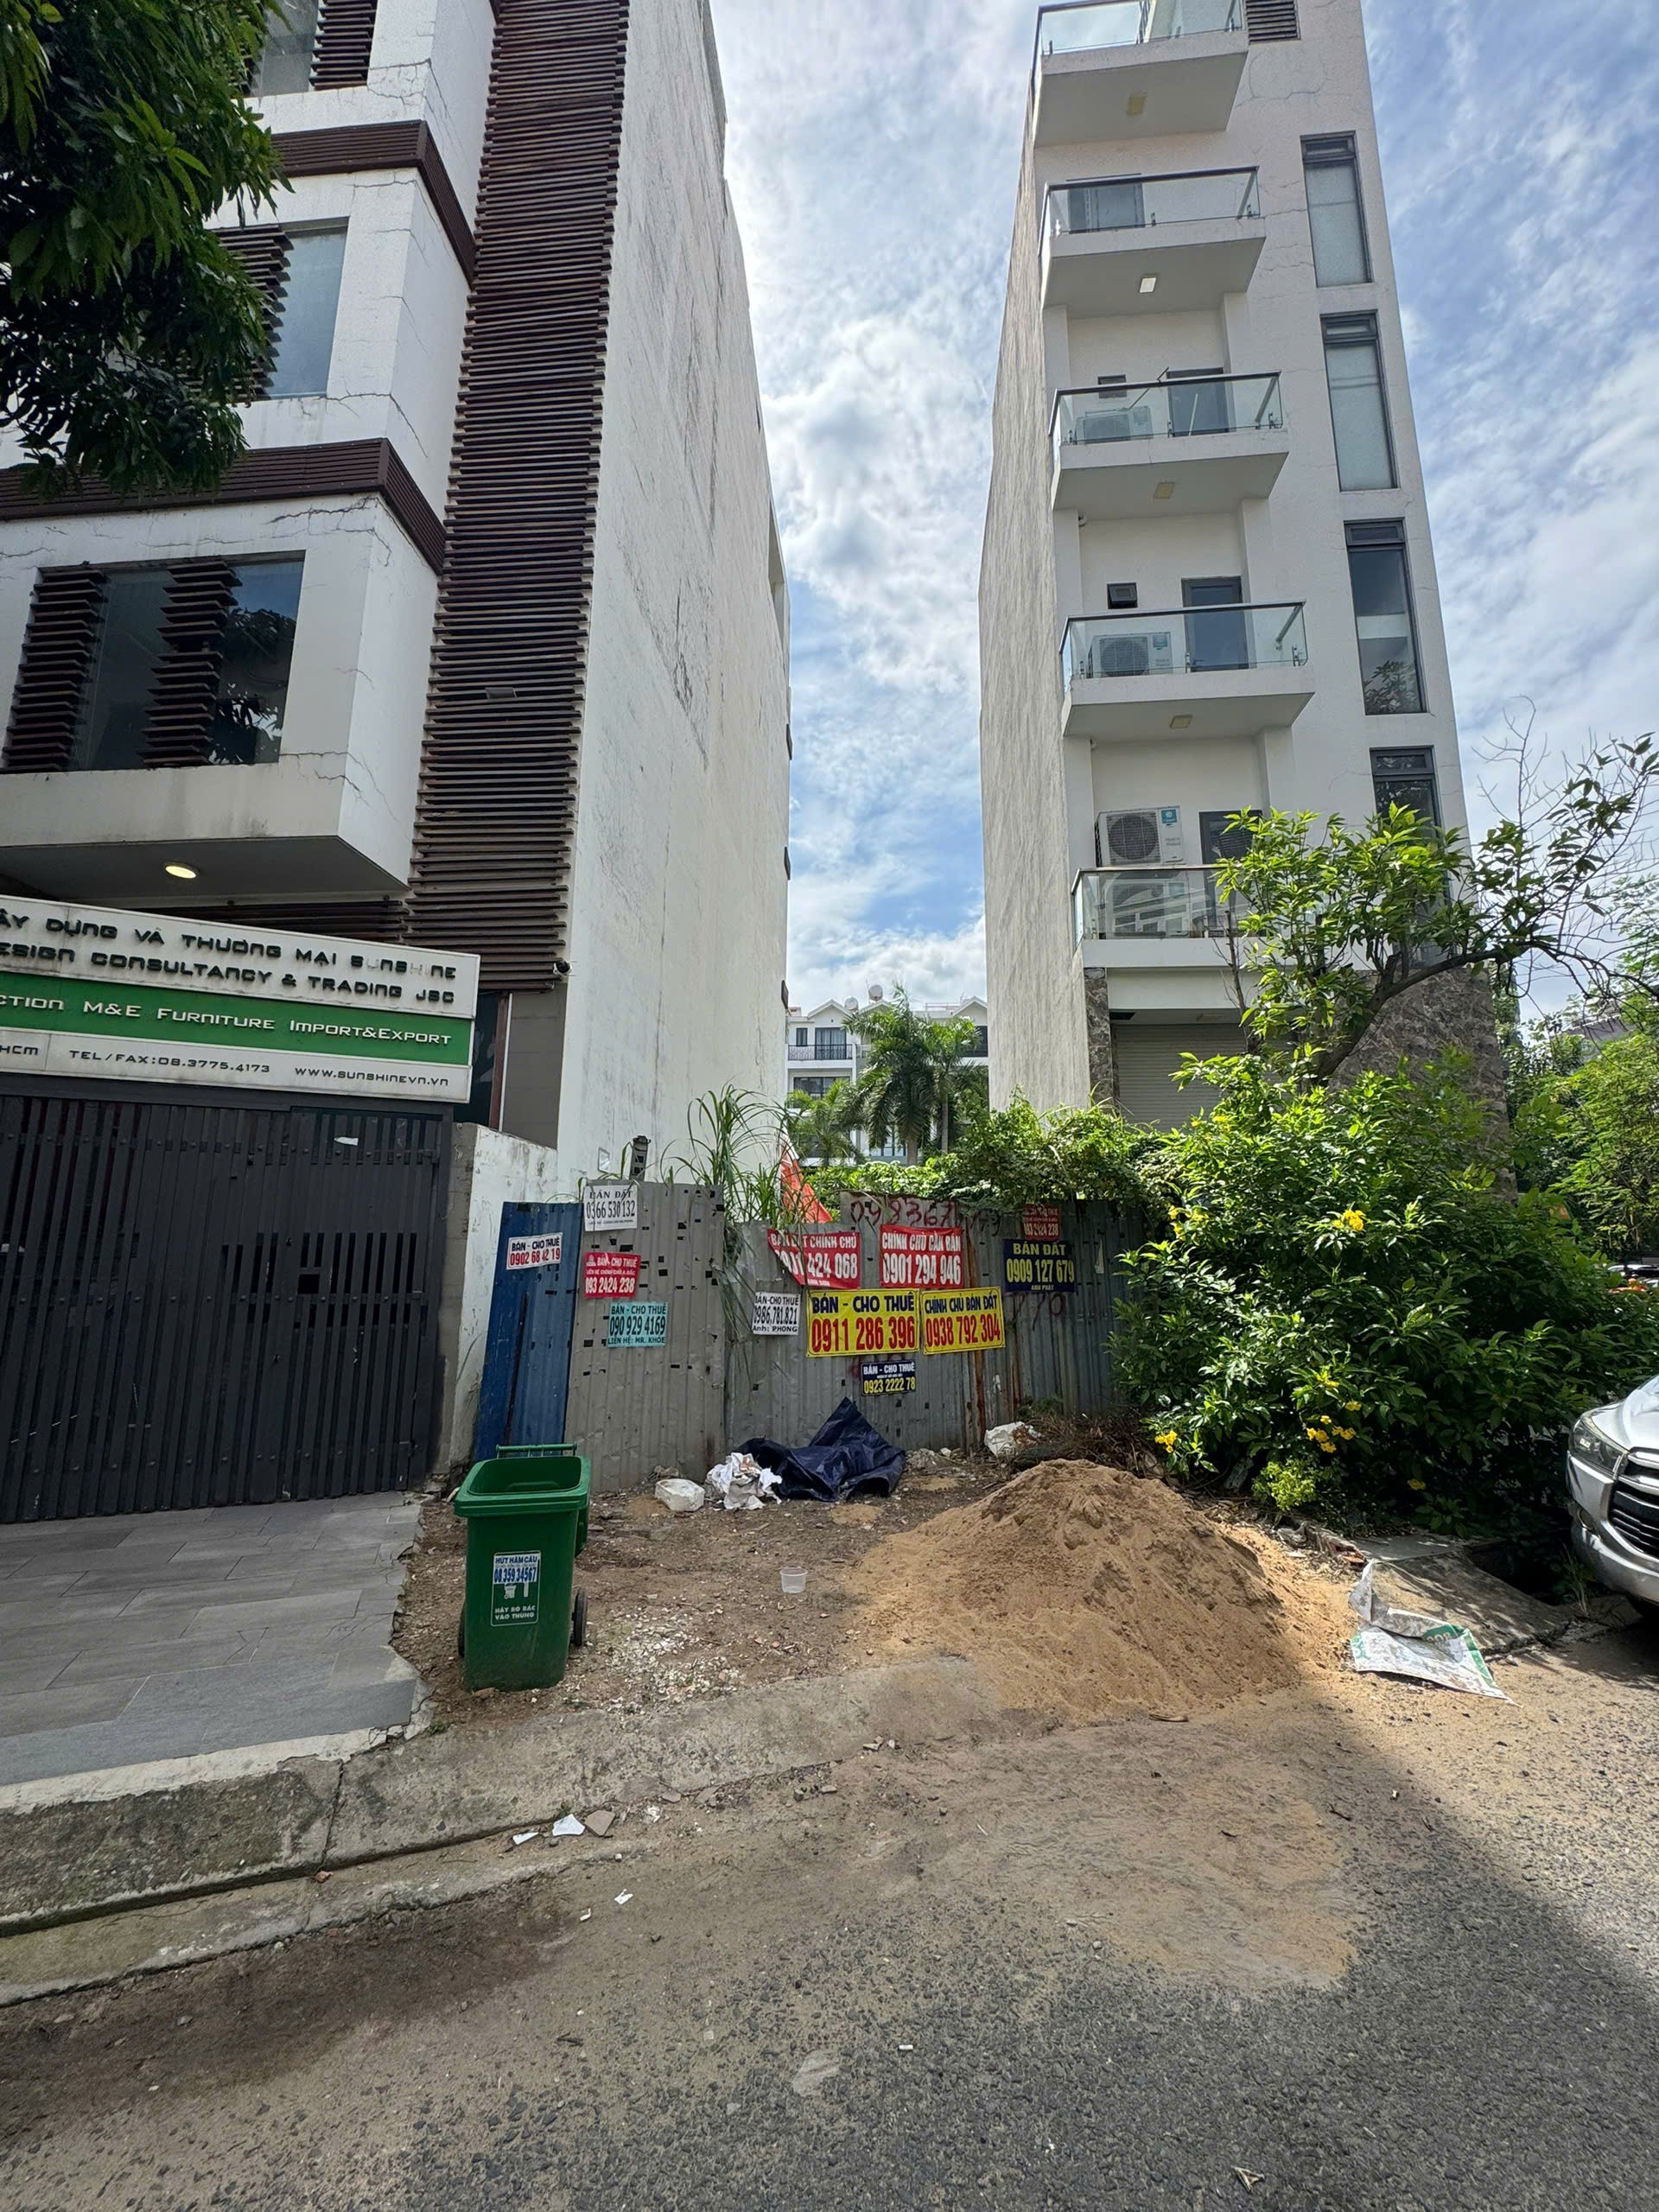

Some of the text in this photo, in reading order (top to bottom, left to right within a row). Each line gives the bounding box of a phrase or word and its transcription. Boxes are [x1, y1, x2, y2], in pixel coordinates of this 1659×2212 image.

[296, 948, 336, 967] MẠI
[91, 952, 272, 984] CONSULTANCY
[282, 974, 296, 988] &
[308, 976, 403, 998] TRADING
[416, 989, 454, 1004] JSC
[83, 1001, 142, 1018] M&E
[157, 1008, 275, 1030] FURNITURE
[587, 1201, 607, 1219] 0366
[622, 1199, 635, 1217] 132
[512, 1241, 526, 1252] BÁN
[532, 1240, 545, 1249] CHO
[545, 1236, 560, 1247] THUÊ
[810, 1234, 837, 1248] CHÍNH
[839, 1232, 857, 1249] CHỦ
[882, 1230, 907, 1249] CHÍNH
[910, 1231, 927, 1251] CHỦ
[945, 1233, 961, 1251] BÁN
[1013, 1240, 1066, 1255] BÁN ĐẤT
[510, 1252, 530, 1266] 0902
[531, 1250, 541, 1263] 68
[551, 1248, 561, 1261] 19
[807, 1252, 831, 1278] 424
[835, 1252, 857, 1279] 068
[883, 1253, 961, 1285] 0901 294 946
[1007, 1258, 1075, 1283] 0909 127 679
[586, 1277, 636, 1294] 093 2424 238
[611, 1303, 625, 1314] BÁN
[631, 1306, 646, 1314] CHO
[648, 1303, 666, 1314] THUÊ
[812, 1293, 839, 1313] BÁN
[853, 1295, 880, 1313] CHO
[884, 1291, 914, 1312] THUÊ
[925, 1290, 997, 1313] CHÍNH CHỦ BÁN ĐẤT
[610, 1316, 666, 1336] 090 929 4169
[812, 1316, 915, 1352] 0911 286 396
[926, 1313, 1001, 1347] 0938 792 304
[863, 1364, 878, 1375] BÁN
[884, 1364, 898, 1374] CHO
[899, 1362, 915, 1372] THUÊ
[864, 1376, 915, 1394] 0923 2222 78
